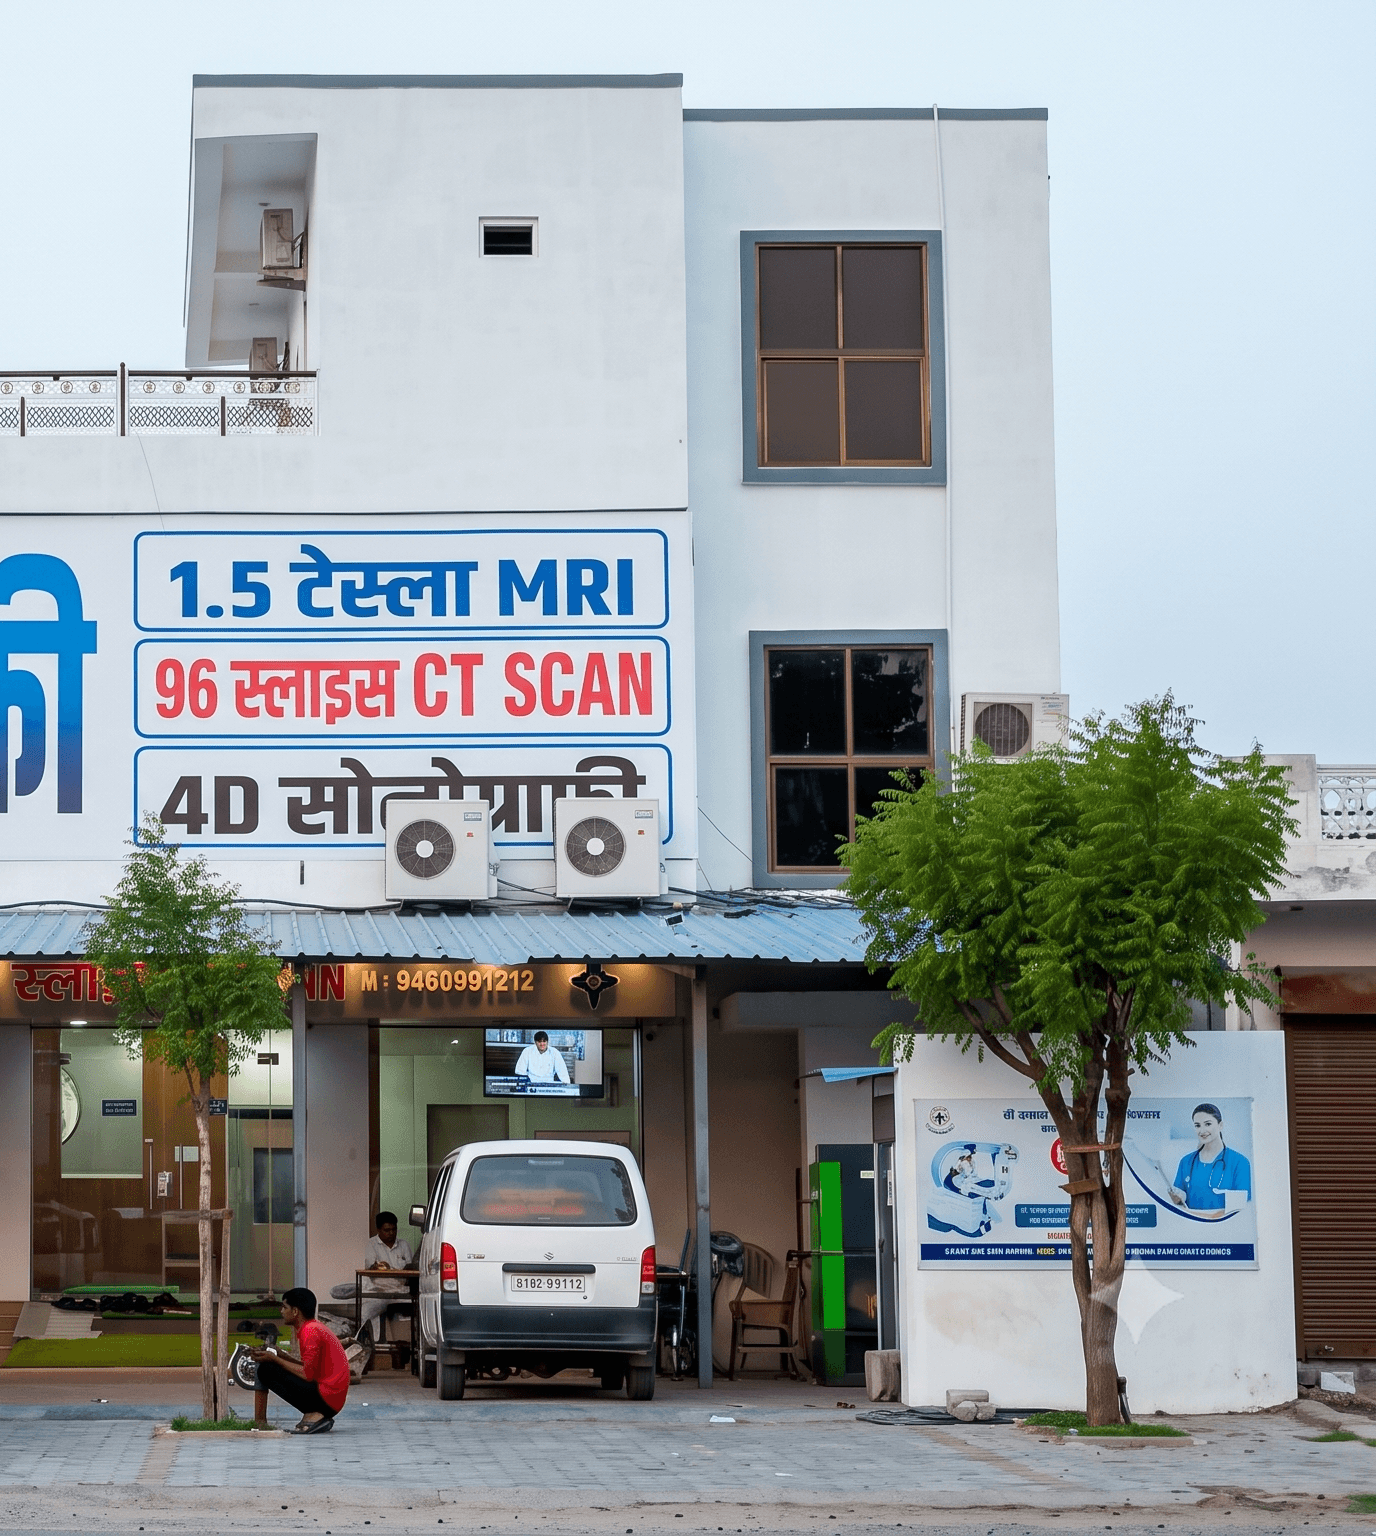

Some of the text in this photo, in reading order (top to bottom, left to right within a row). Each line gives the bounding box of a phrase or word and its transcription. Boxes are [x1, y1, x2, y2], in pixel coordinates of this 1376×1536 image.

[170, 544, 635, 619] 1.5 टेस्ला MRI
[155, 652, 653, 725] 96 स्लाइस CT SCAN
[159, 775, 260, 835] 4D
[396, 969, 535, 993] 9460991212
